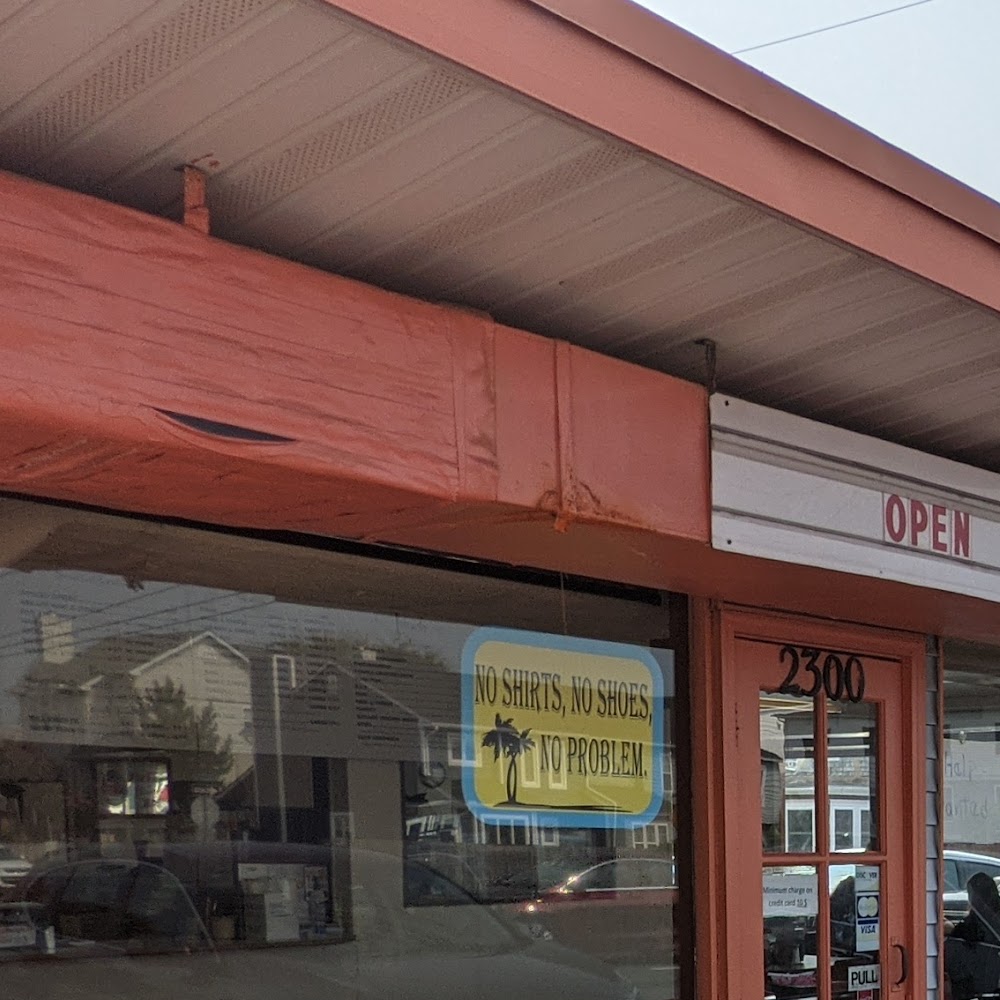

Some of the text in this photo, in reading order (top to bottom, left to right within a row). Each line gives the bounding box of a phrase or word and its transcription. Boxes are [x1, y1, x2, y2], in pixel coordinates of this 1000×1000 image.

[885, 494, 970, 558] OPEN
[779, 645, 865, 702] 2300
[475, 664, 497, 706] NO
[502, 668, 566, 719] SHIRTS,
[571, 675, 593, 716] NO
[597, 679, 652, 727] SHOES,
[540, 734, 648, 777] NO PROBLEM.
[945, 797, 988, 820] anted
[860, 925, 876, 934] VISA
[851, 971, 878, 986] PULL
